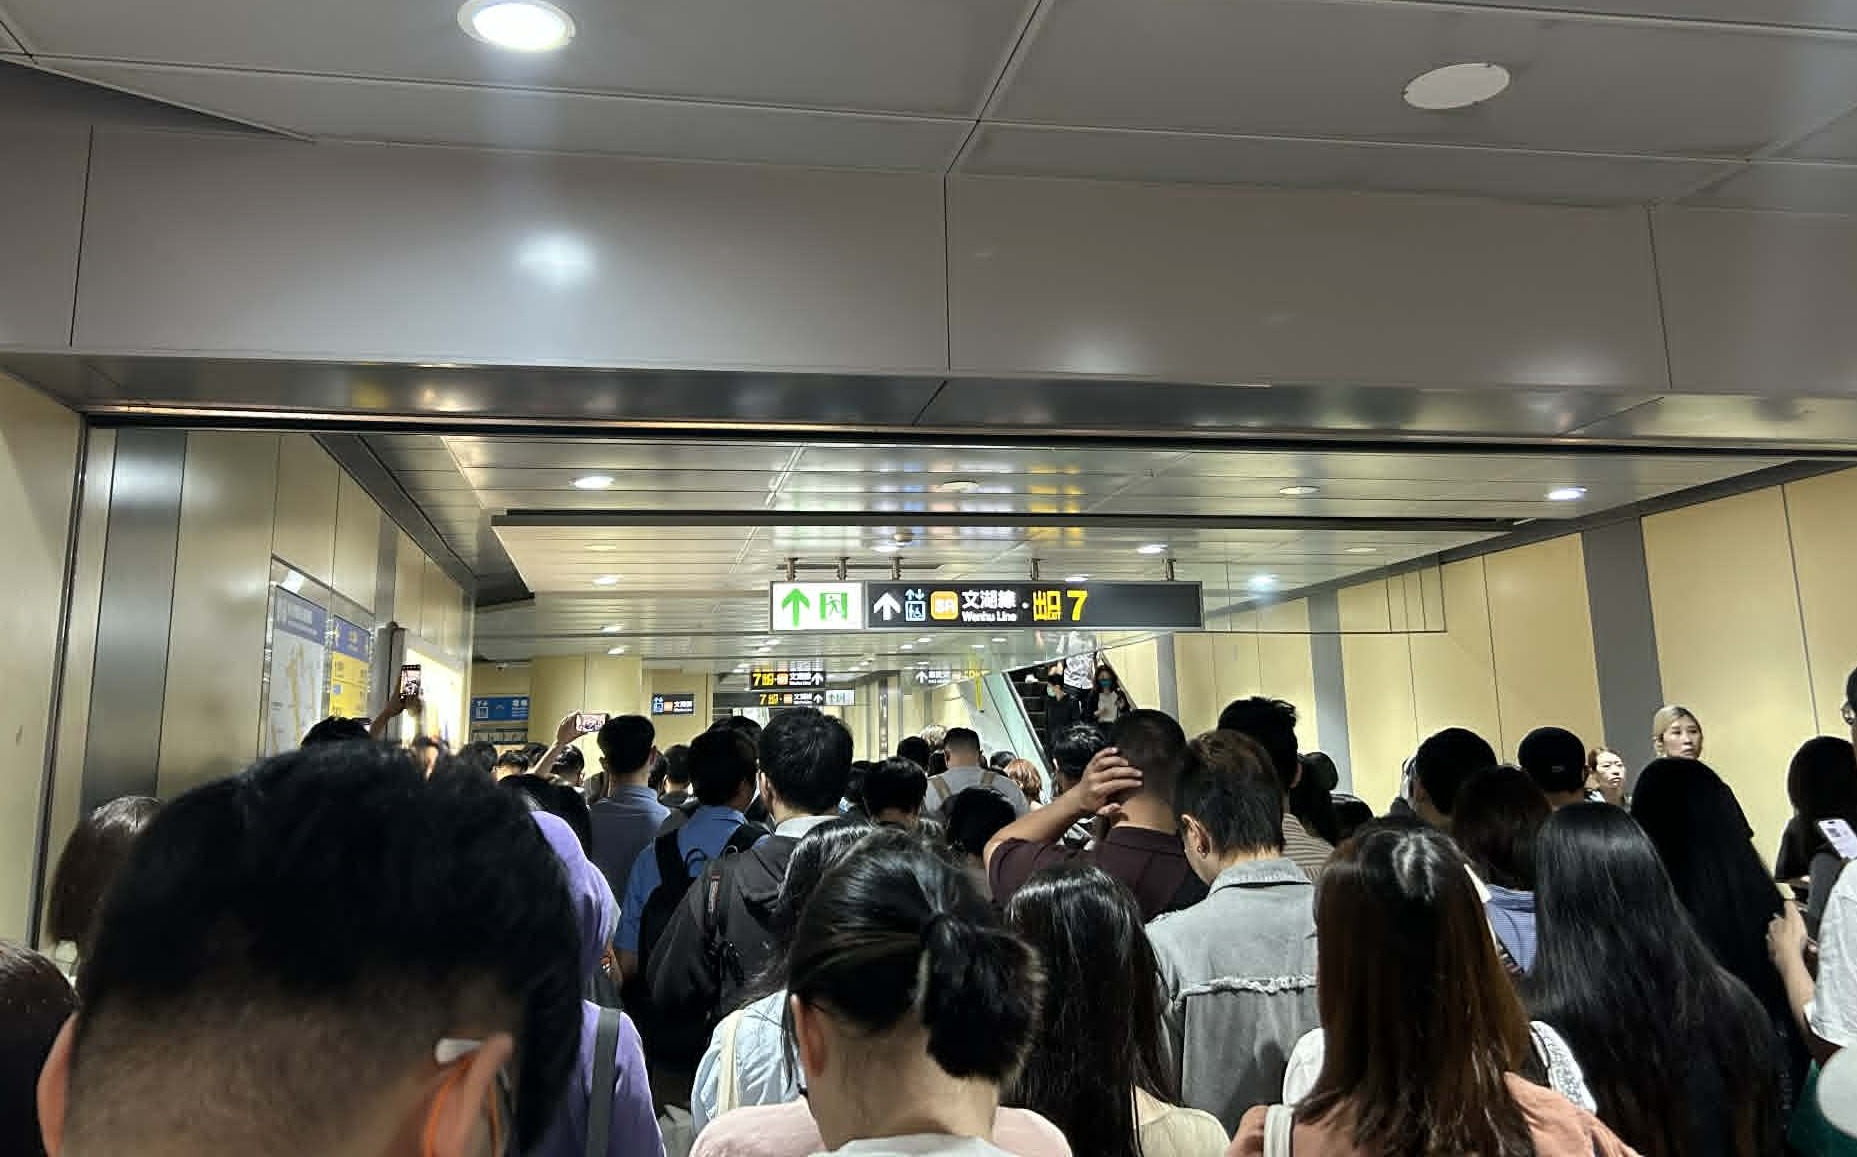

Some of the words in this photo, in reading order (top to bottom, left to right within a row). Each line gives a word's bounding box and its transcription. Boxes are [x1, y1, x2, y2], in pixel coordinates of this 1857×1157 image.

[961, 589, 1017, 609] 文湖線
[1066, 590, 1088, 621] 7
[961, 610, 995, 622] Wenhu
[996, 610, 1017, 622] Line
[753, 673, 761, 686] 7
[760, 694, 767, 705] 7
